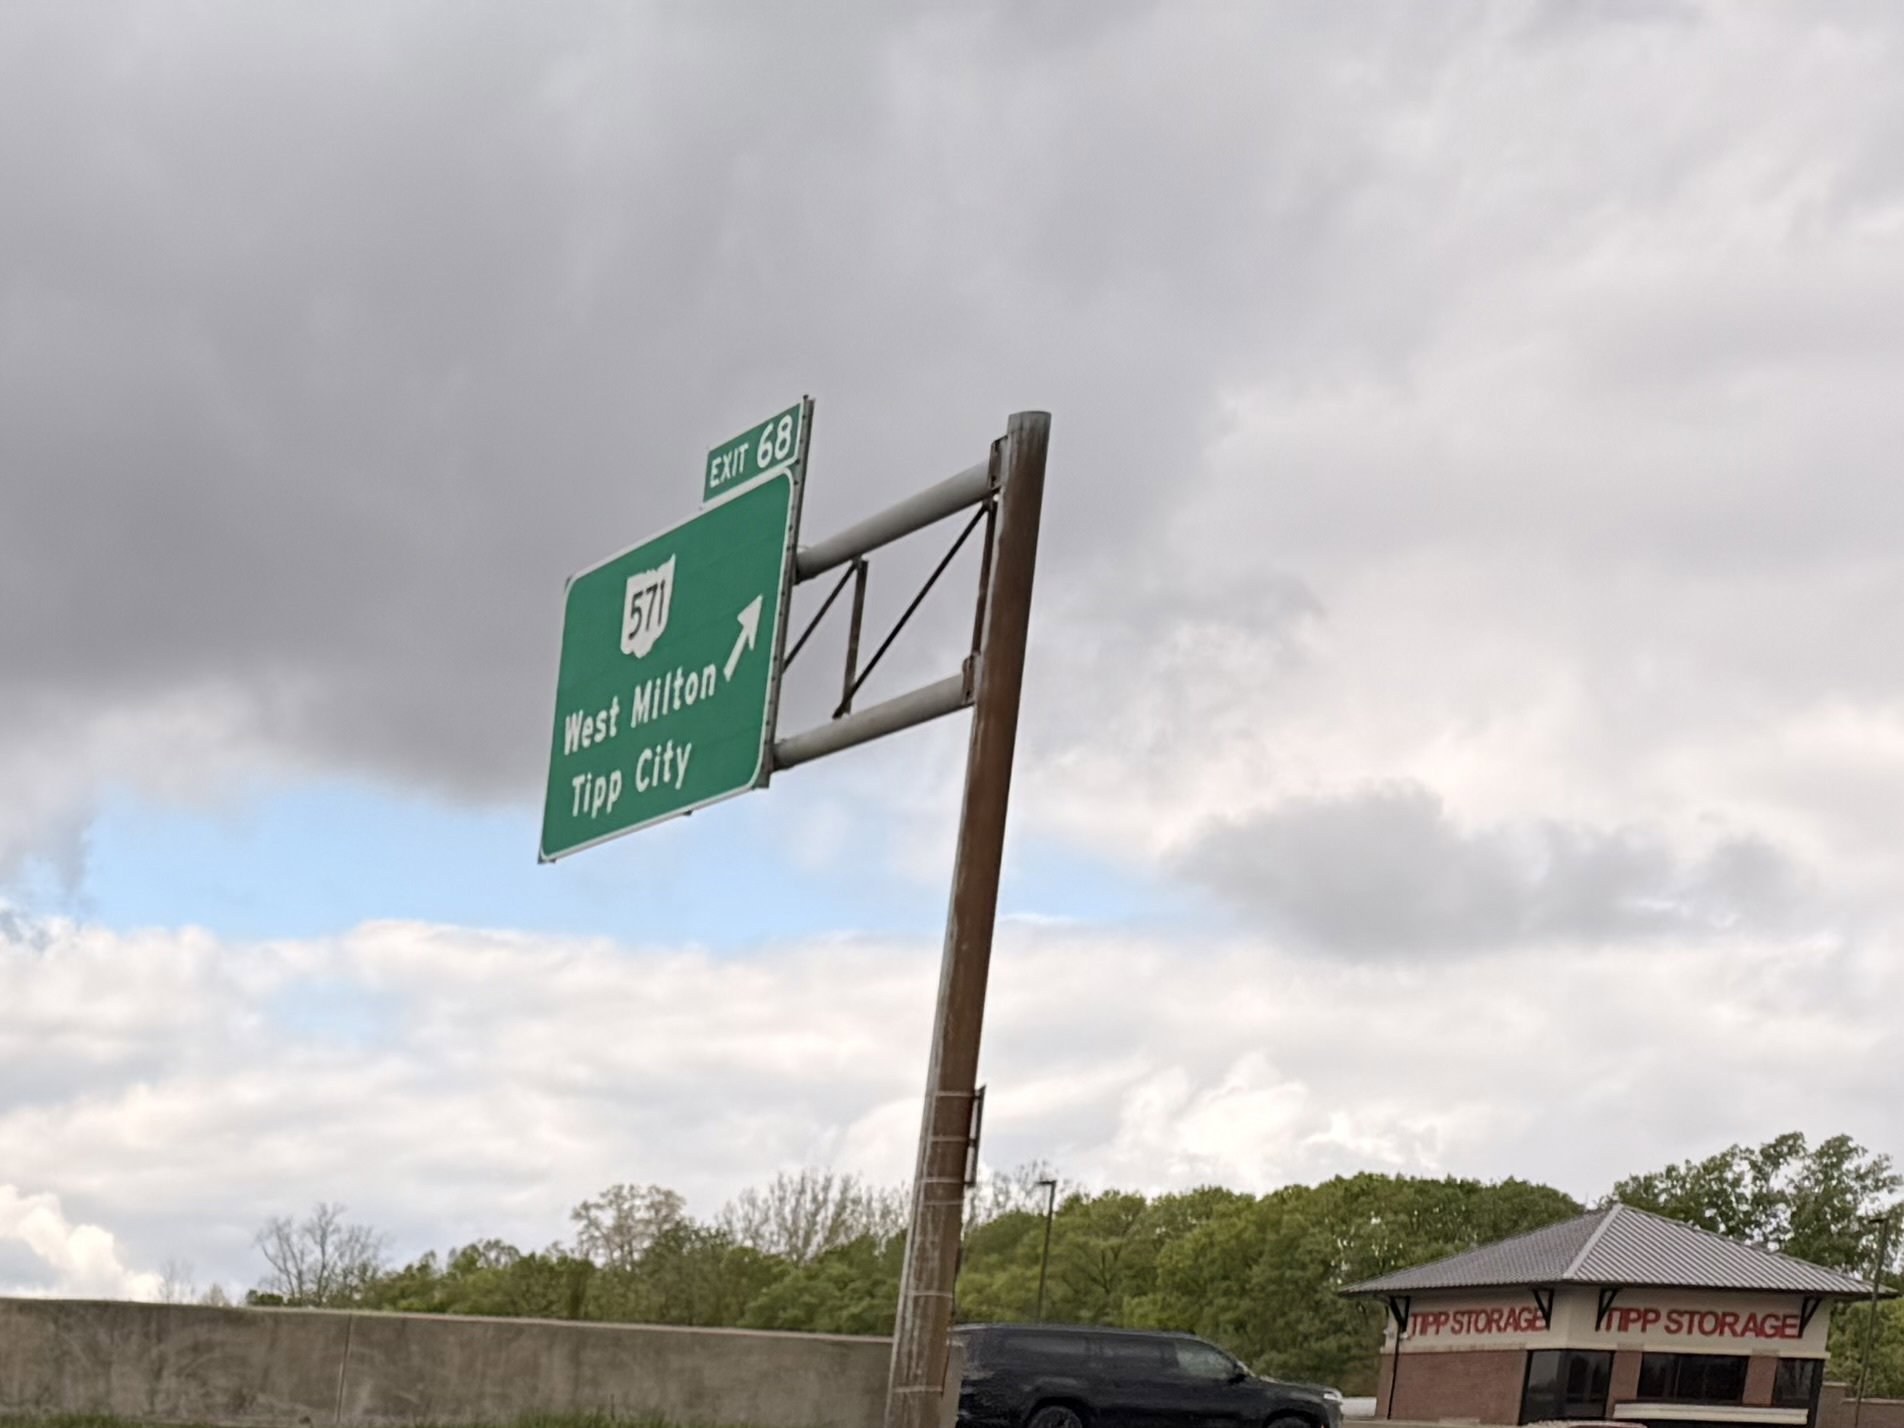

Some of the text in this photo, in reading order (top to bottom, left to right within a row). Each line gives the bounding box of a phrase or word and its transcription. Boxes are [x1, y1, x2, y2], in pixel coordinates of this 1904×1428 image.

[709, 414, 793, 488] EXIT 68
[628, 579, 667, 641] 571
[563, 662, 716, 757] West Milton
[571, 740, 693, 819] Tipp City
[1407, 1305, 1549, 1337] TIPP STORAGE
[1603, 1307, 1801, 1339] TIPP STORAGE
